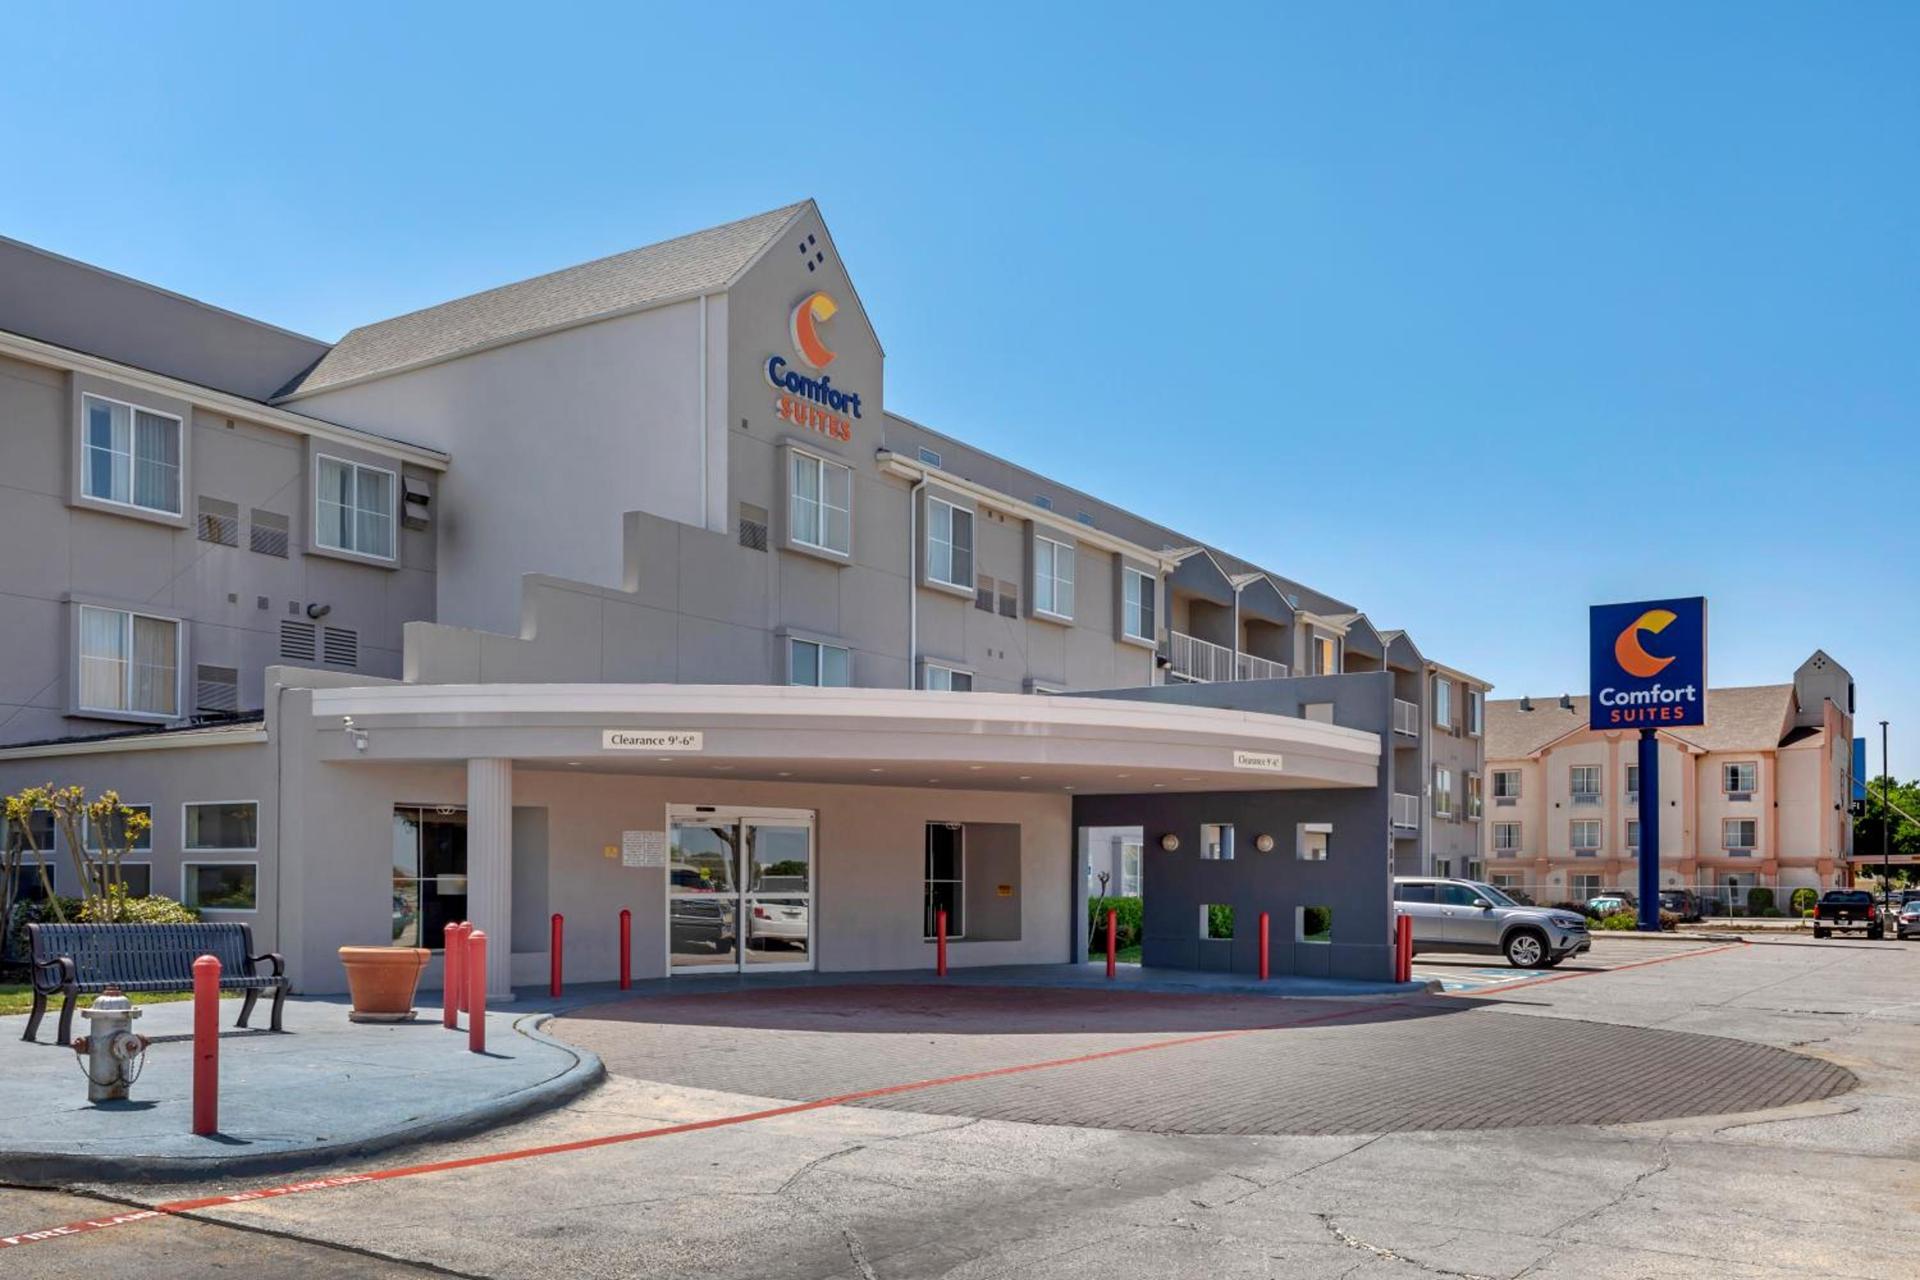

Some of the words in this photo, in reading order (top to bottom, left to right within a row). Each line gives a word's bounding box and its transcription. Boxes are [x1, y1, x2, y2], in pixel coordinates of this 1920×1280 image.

[768, 357, 862, 419] Comfort
[778, 395, 851, 441] SUITES
[1599, 683, 1696, 706] Comfort
[1610, 706, 1685, 722] SUITES
[611, 734, 665, 746] Clearance
[1, 1225, 80, 1245] FIRE
